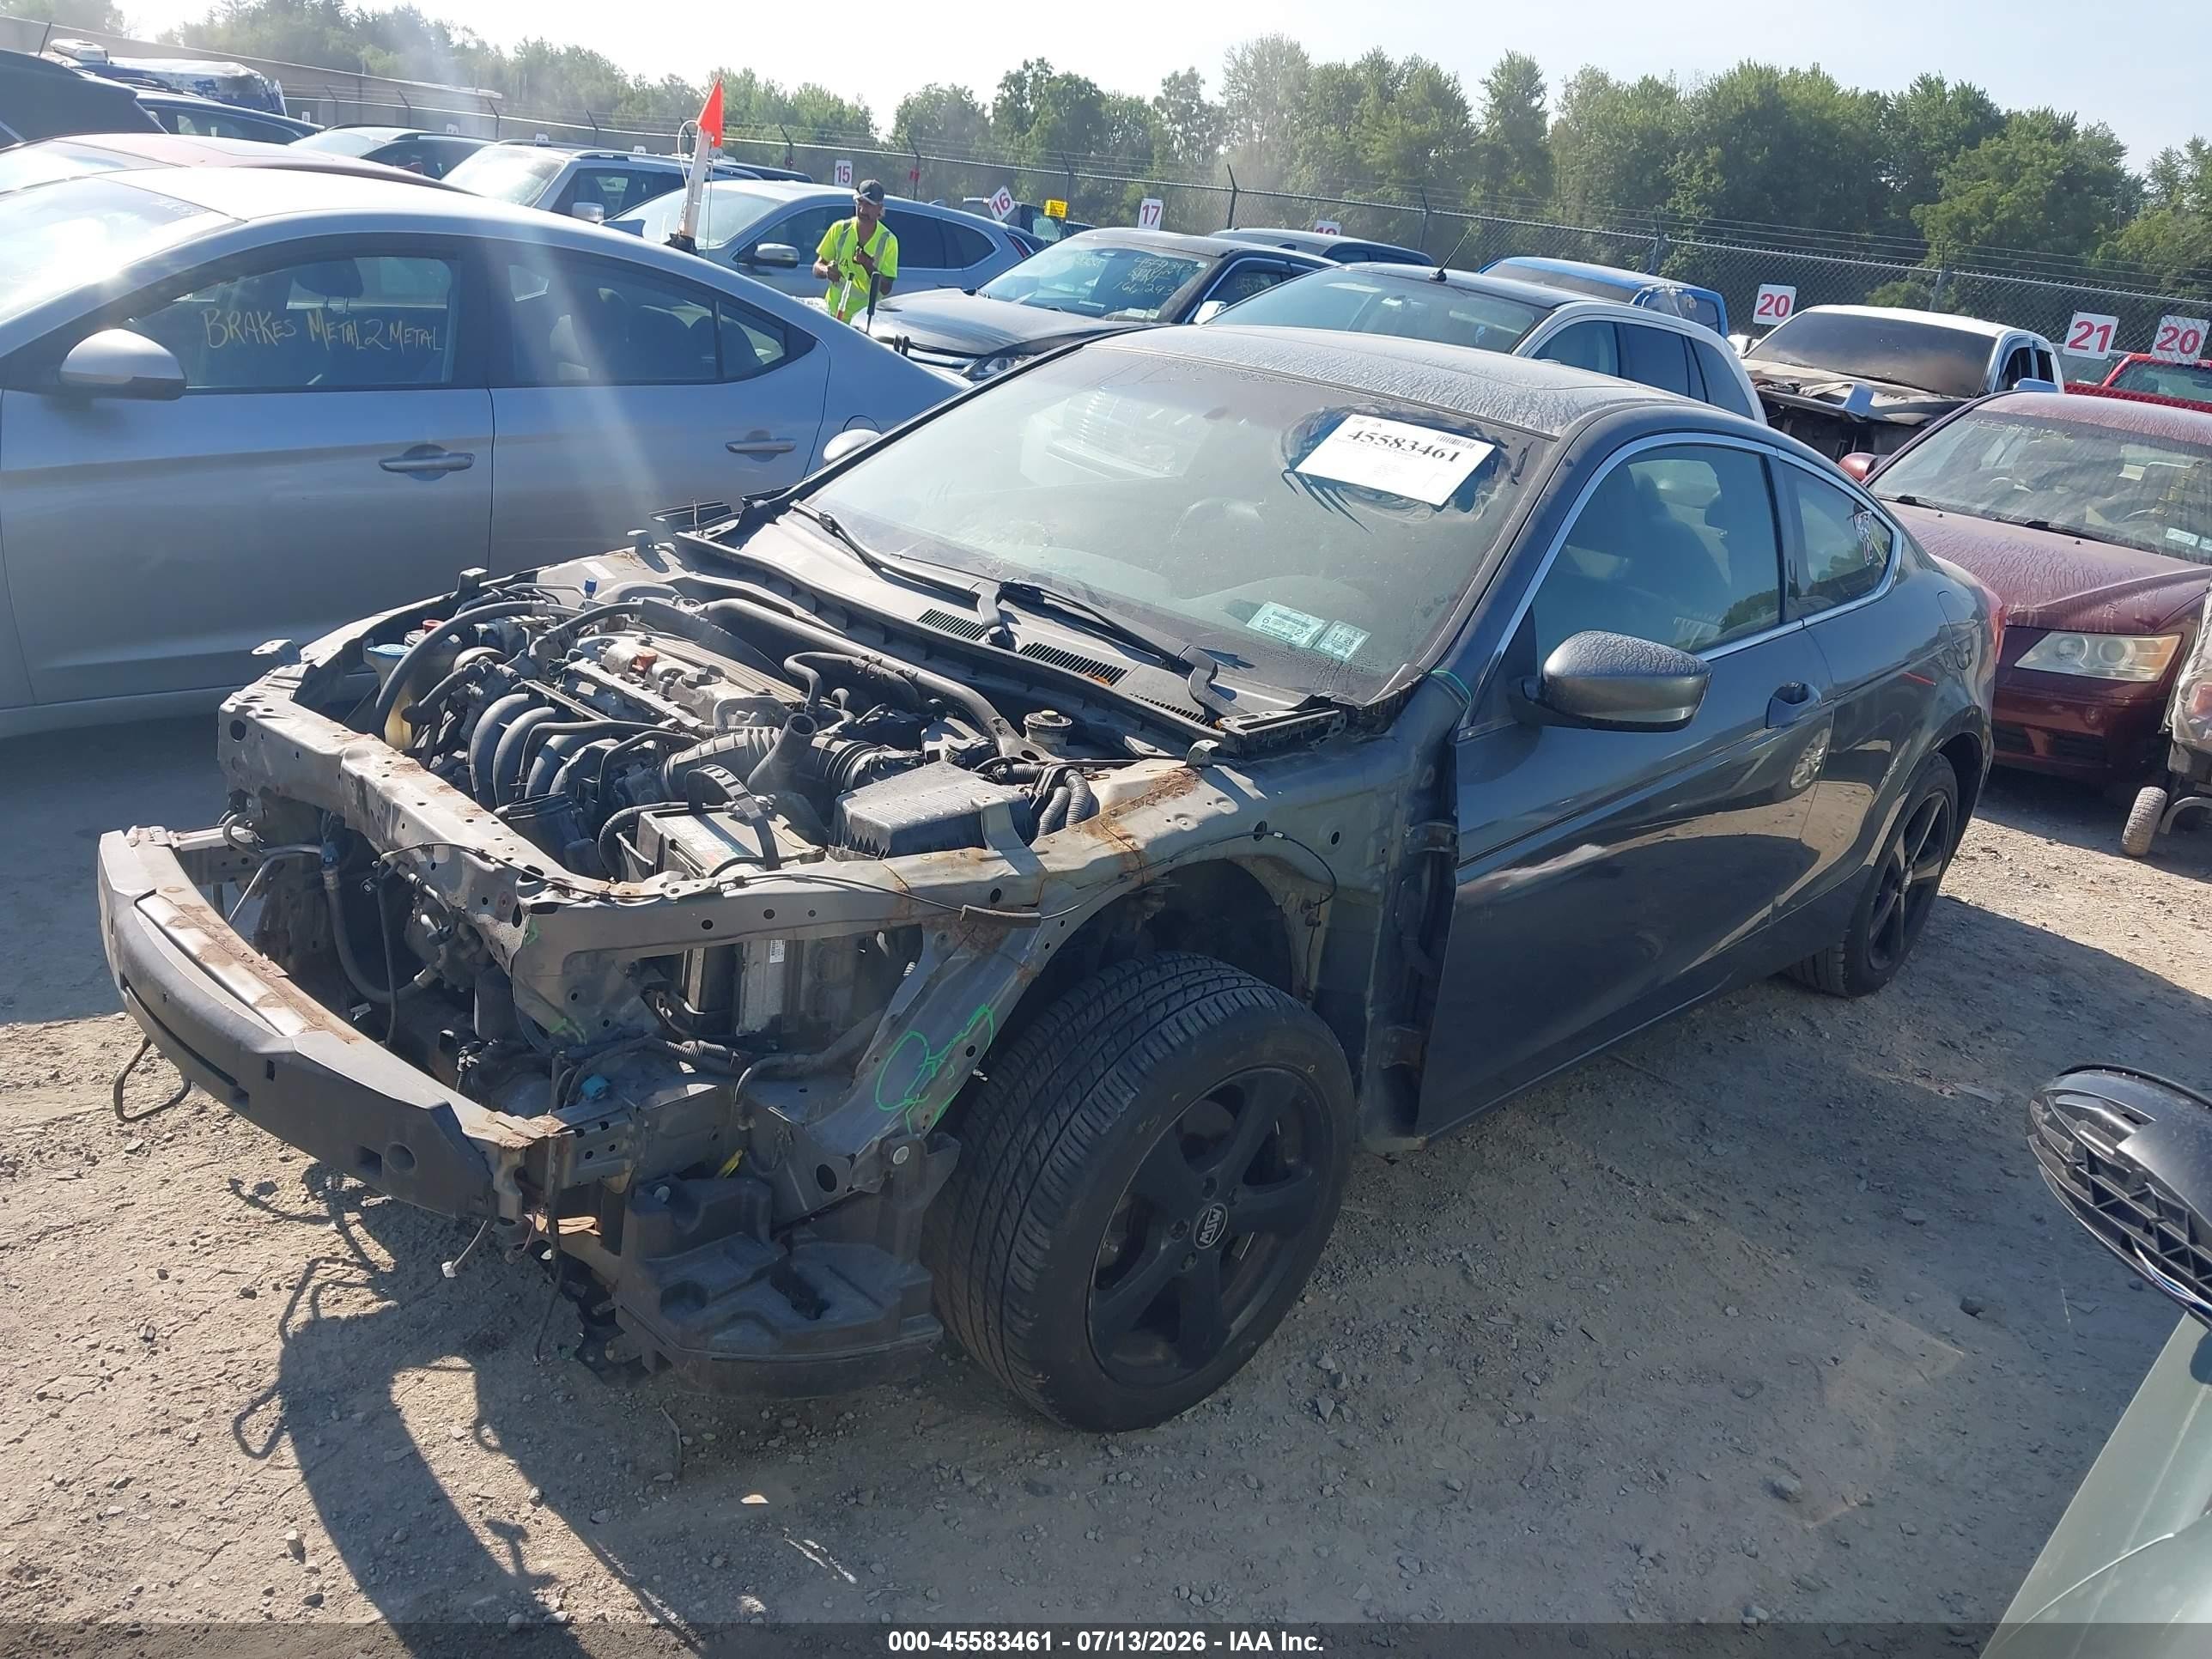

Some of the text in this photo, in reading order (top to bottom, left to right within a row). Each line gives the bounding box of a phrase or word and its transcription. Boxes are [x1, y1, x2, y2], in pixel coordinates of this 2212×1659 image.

[836, 164, 852, 184] 15
[991, 192, 1012, 216] 16
[1141, 204, 1162, 225] 17
[1757, 293, 1791, 318] 20
[200, 307, 297, 349] BRAKES
[364, 319, 392, 351] 2
[388, 319, 445, 355] METAL
[2068, 320, 2113, 353] 21
[2156, 325, 2201, 355] 20
[1347, 429, 1462, 463] 45583461
[1293, 629, 1313, 639] 27
